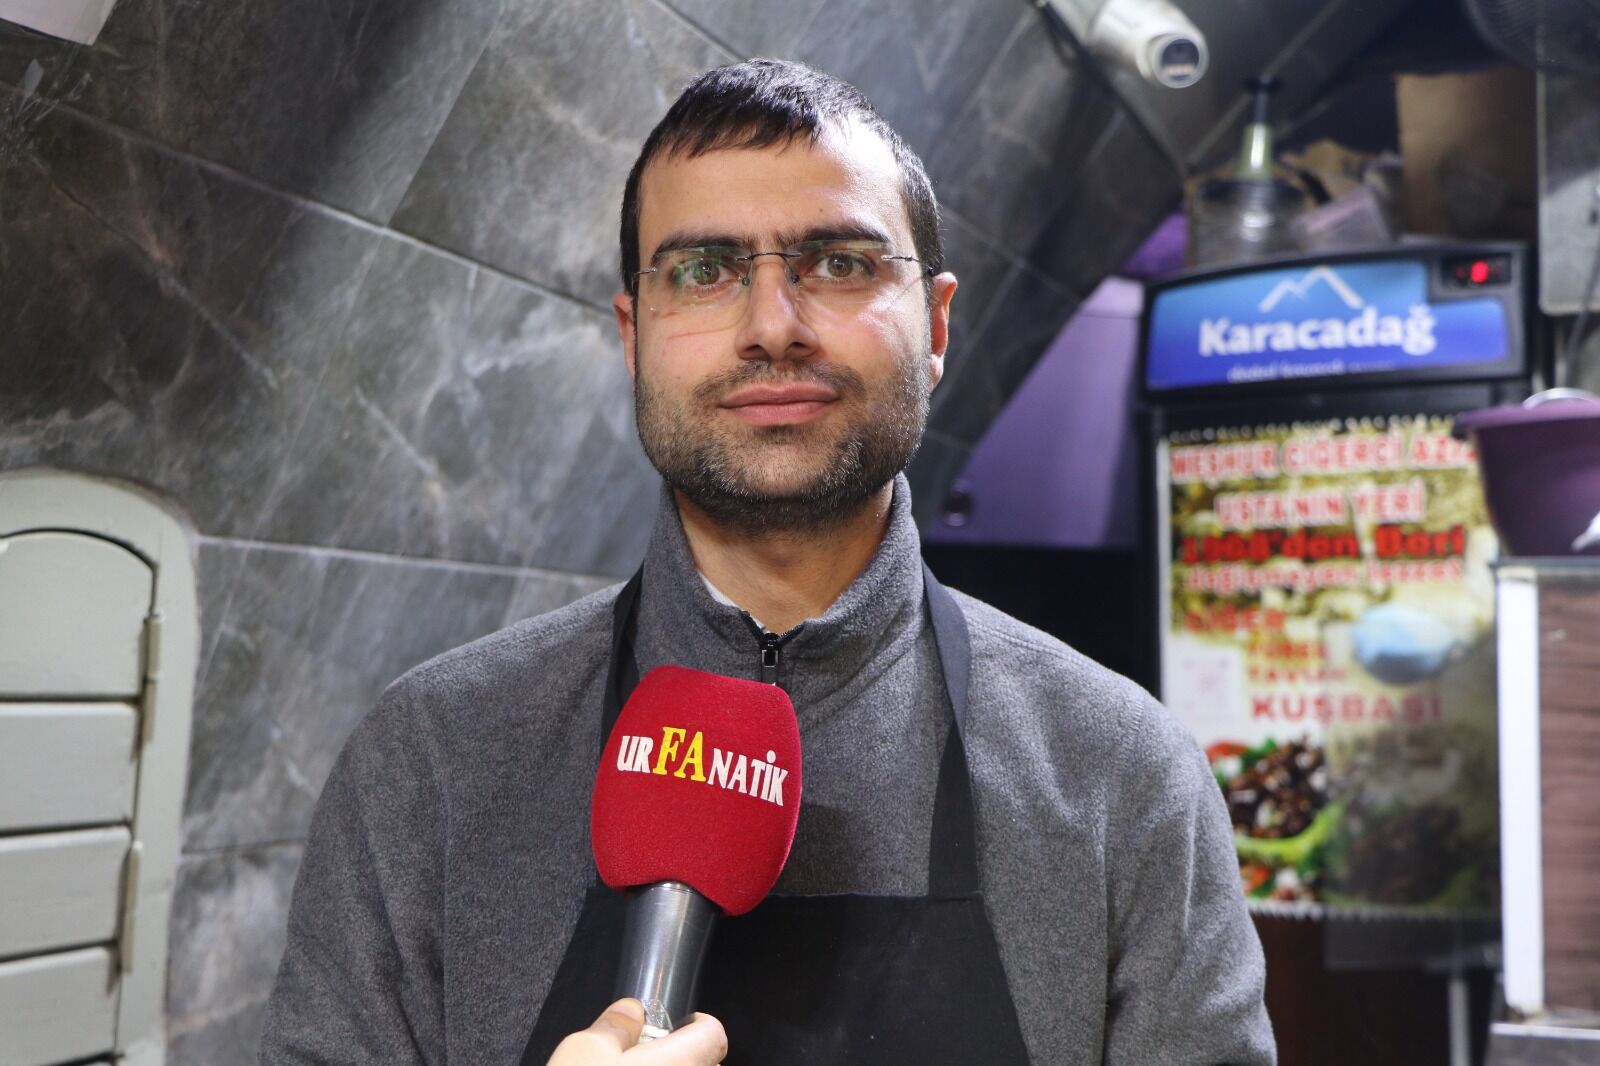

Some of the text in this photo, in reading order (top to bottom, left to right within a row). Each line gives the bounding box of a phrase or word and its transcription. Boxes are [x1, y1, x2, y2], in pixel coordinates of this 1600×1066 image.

[1200, 304, 1436, 356] Karacadağ
[1170, 444, 1278, 483] MEŞHUR
[1216, 480, 1424, 529] USTANIN YERİ
[1375, 525, 1466, 557] Beri
